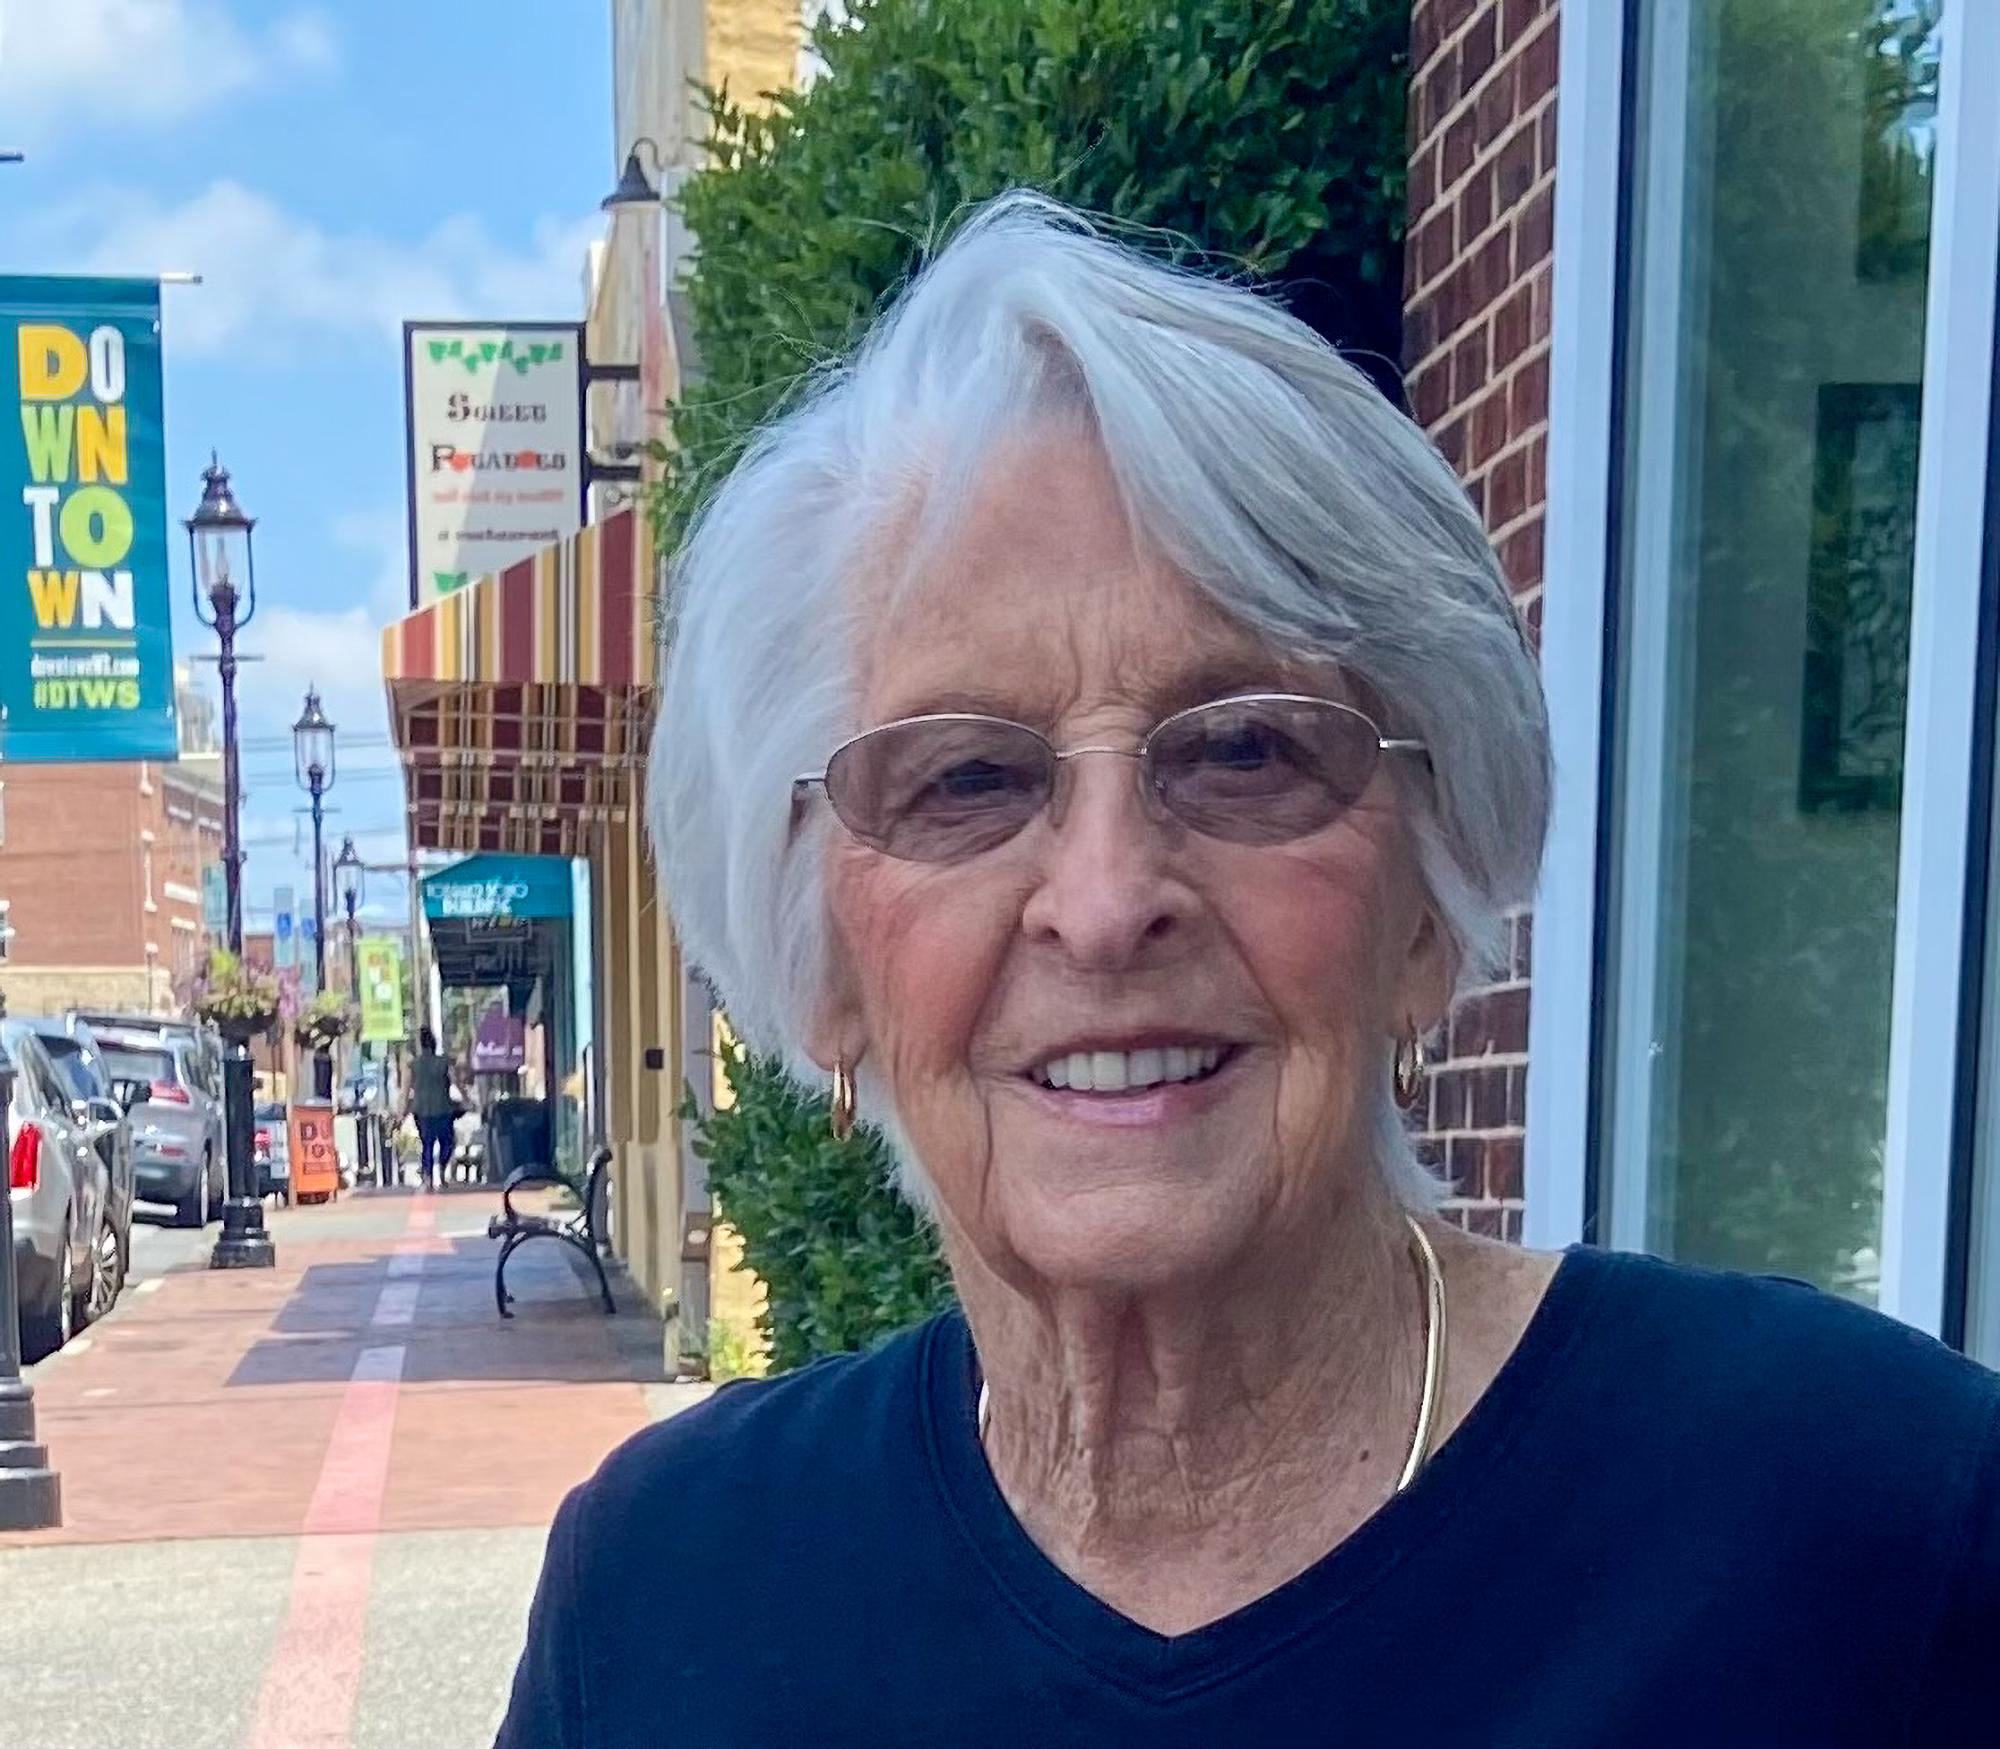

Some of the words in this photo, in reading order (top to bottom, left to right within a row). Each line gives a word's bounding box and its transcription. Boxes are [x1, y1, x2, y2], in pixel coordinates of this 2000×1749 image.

[17, 324, 127, 403] DO
[20, 404, 129, 484] WN
[22, 485, 135, 570] TO
[27, 569, 136, 631] WN
[33, 679, 141, 710] #DTWS
